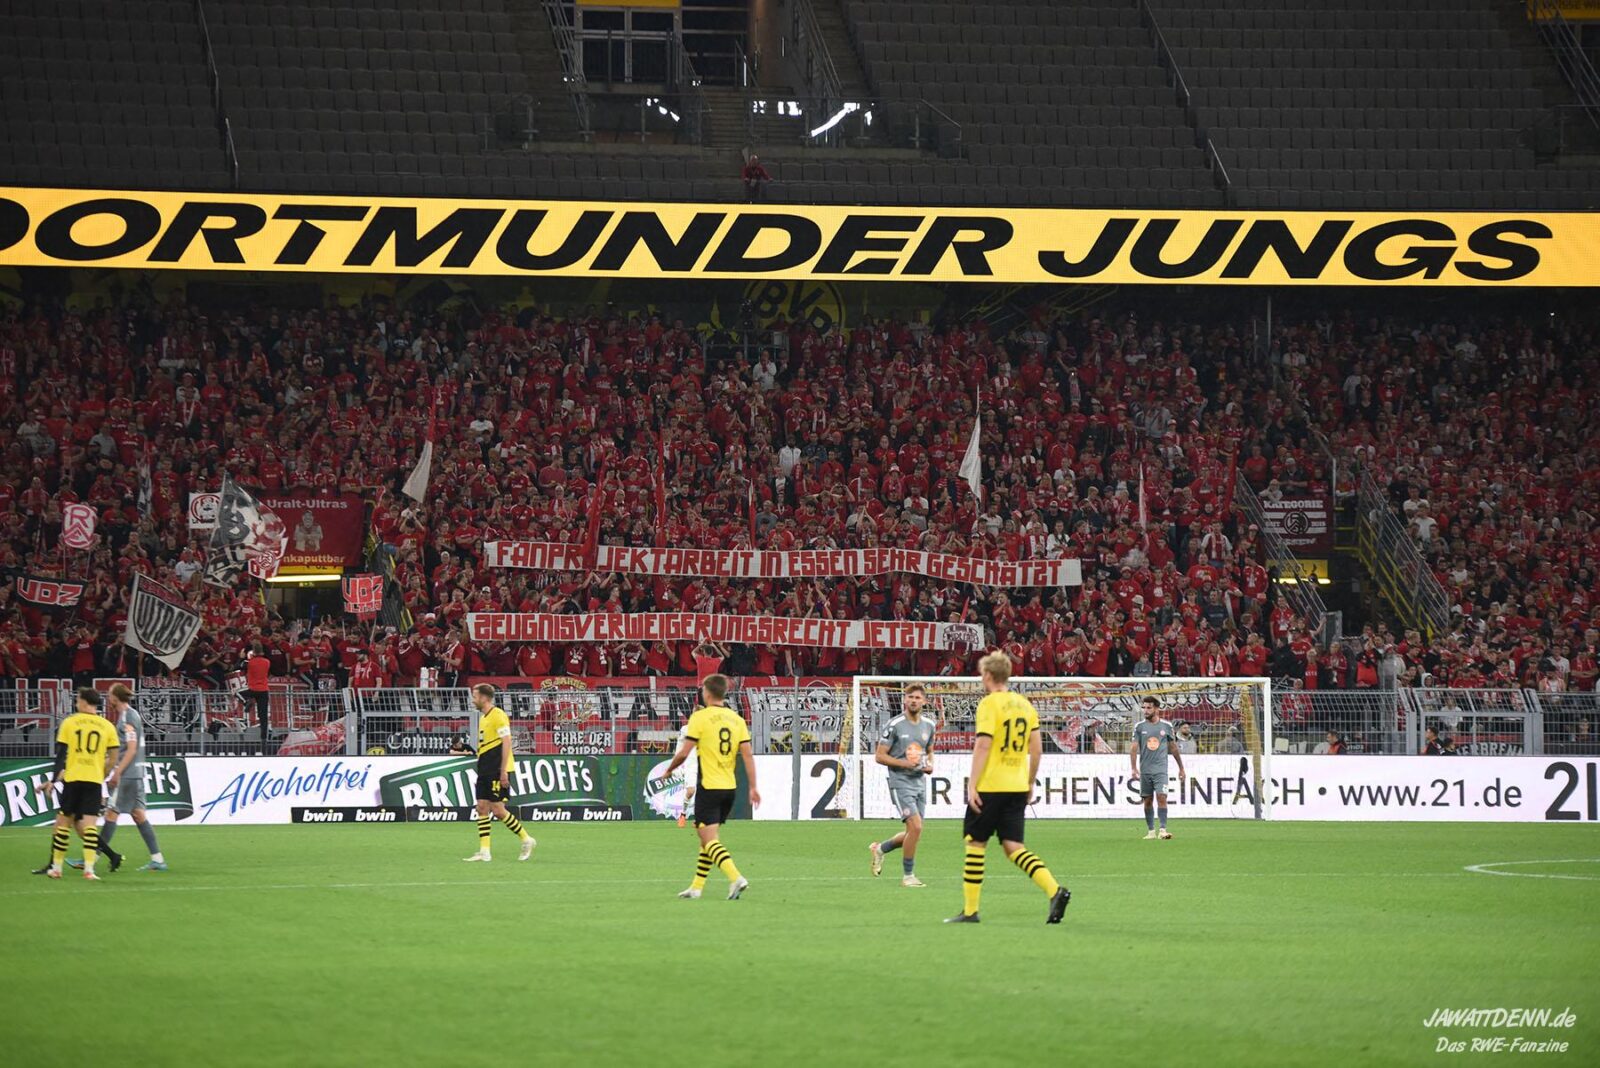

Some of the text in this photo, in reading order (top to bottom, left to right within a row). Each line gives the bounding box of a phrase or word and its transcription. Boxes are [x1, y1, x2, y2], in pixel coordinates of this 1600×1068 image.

[1037, 217, 1553, 283] JUNGS
[266, 499, 348, 510] Uralt-Ultras
[1263, 499, 1324, 510] KATEGORIE
[282, 553, 346, 566] nkaputtbar
[496, 542, 1063, 586] FANPRJEKTARBEIT IN ESSEN SEHR GESCHÄTZT
[136, 590, 193, 650] ULTRAS
[474, 613, 852, 648] ZEUGNISVERWEIGERUNGSRECHT
[857, 620, 937, 649] JETZT!
[75, 729, 101, 755] 10
[588, 731, 613, 747] DER
[718, 727, 732, 756] 8
[1000, 716, 1028, 753] 13
[201, 762, 372, 823] Alkoholfrei
[1338, 777, 1523, 808] www.21.de
[302, 809, 396, 822] bwin bwin
[417, 808, 458, 821] bwin
[531, 808, 623, 821] bwin bwin
